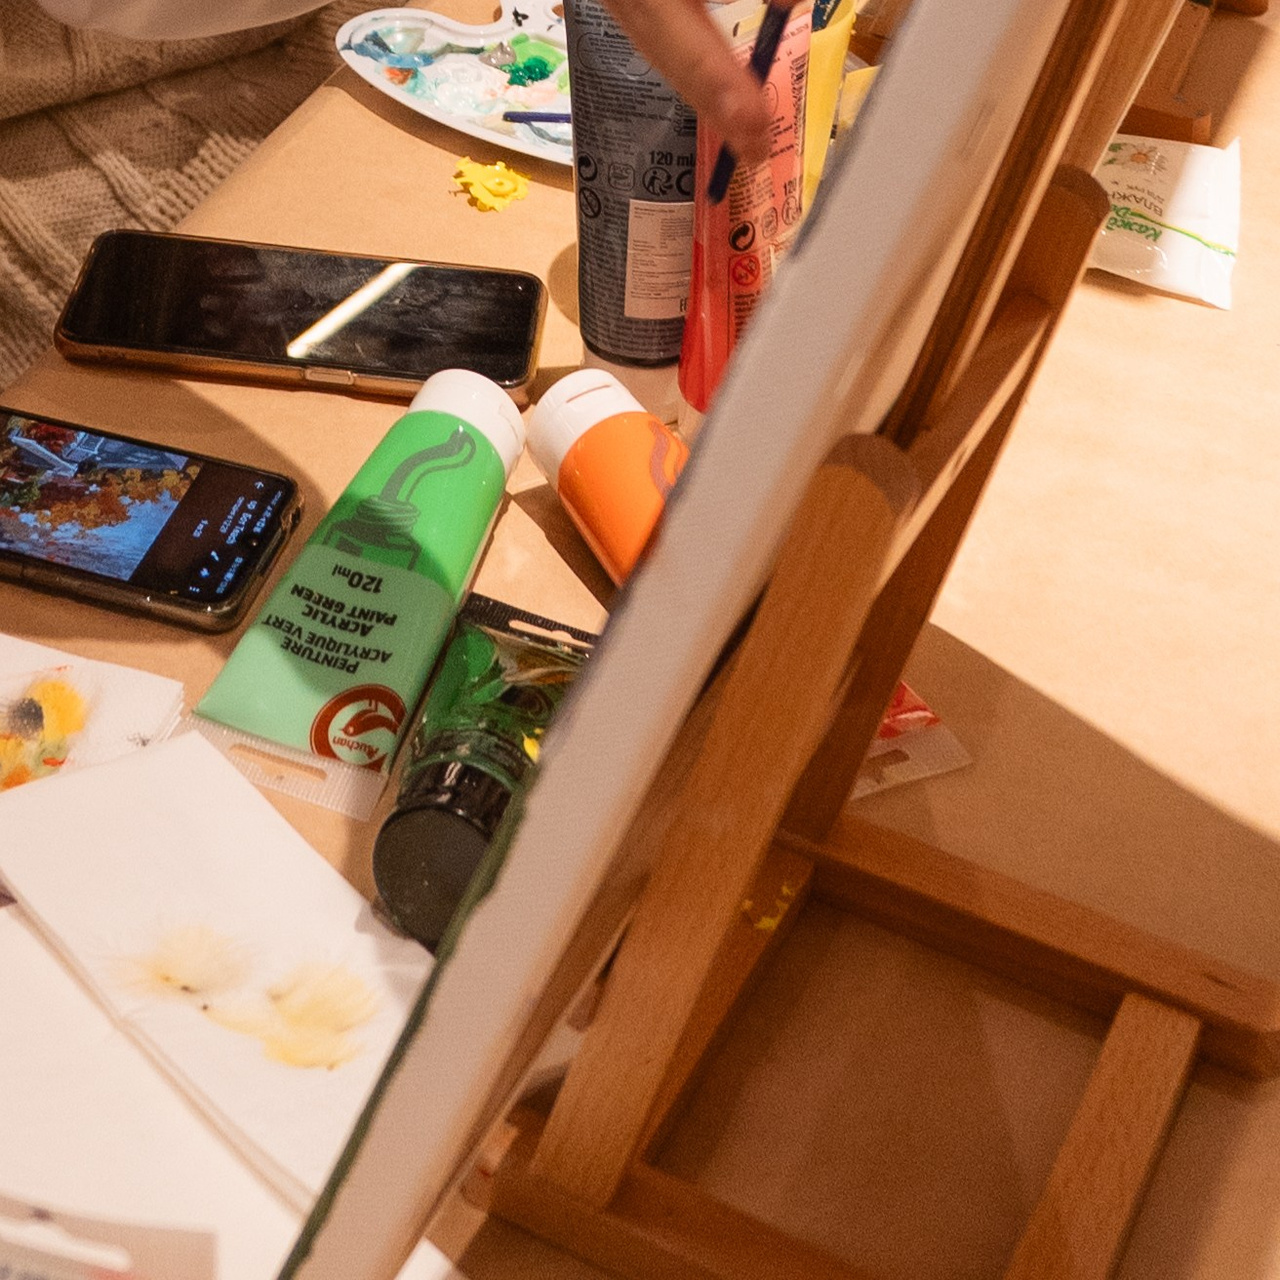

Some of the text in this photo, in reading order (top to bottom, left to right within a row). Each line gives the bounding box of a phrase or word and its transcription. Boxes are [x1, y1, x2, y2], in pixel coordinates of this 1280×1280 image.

[649, 150, 673, 166] 120
[331, 562, 385, 595] 120ml
[290, 583, 398, 627] PAINT GREEN
[301, 603, 375, 637] ACRYLIC
[261, 613, 394, 664] ACRYLIQUE VERT
[279, 637, 360, 675] PEINTURE
[332, 735, 380, 759] Auchan
